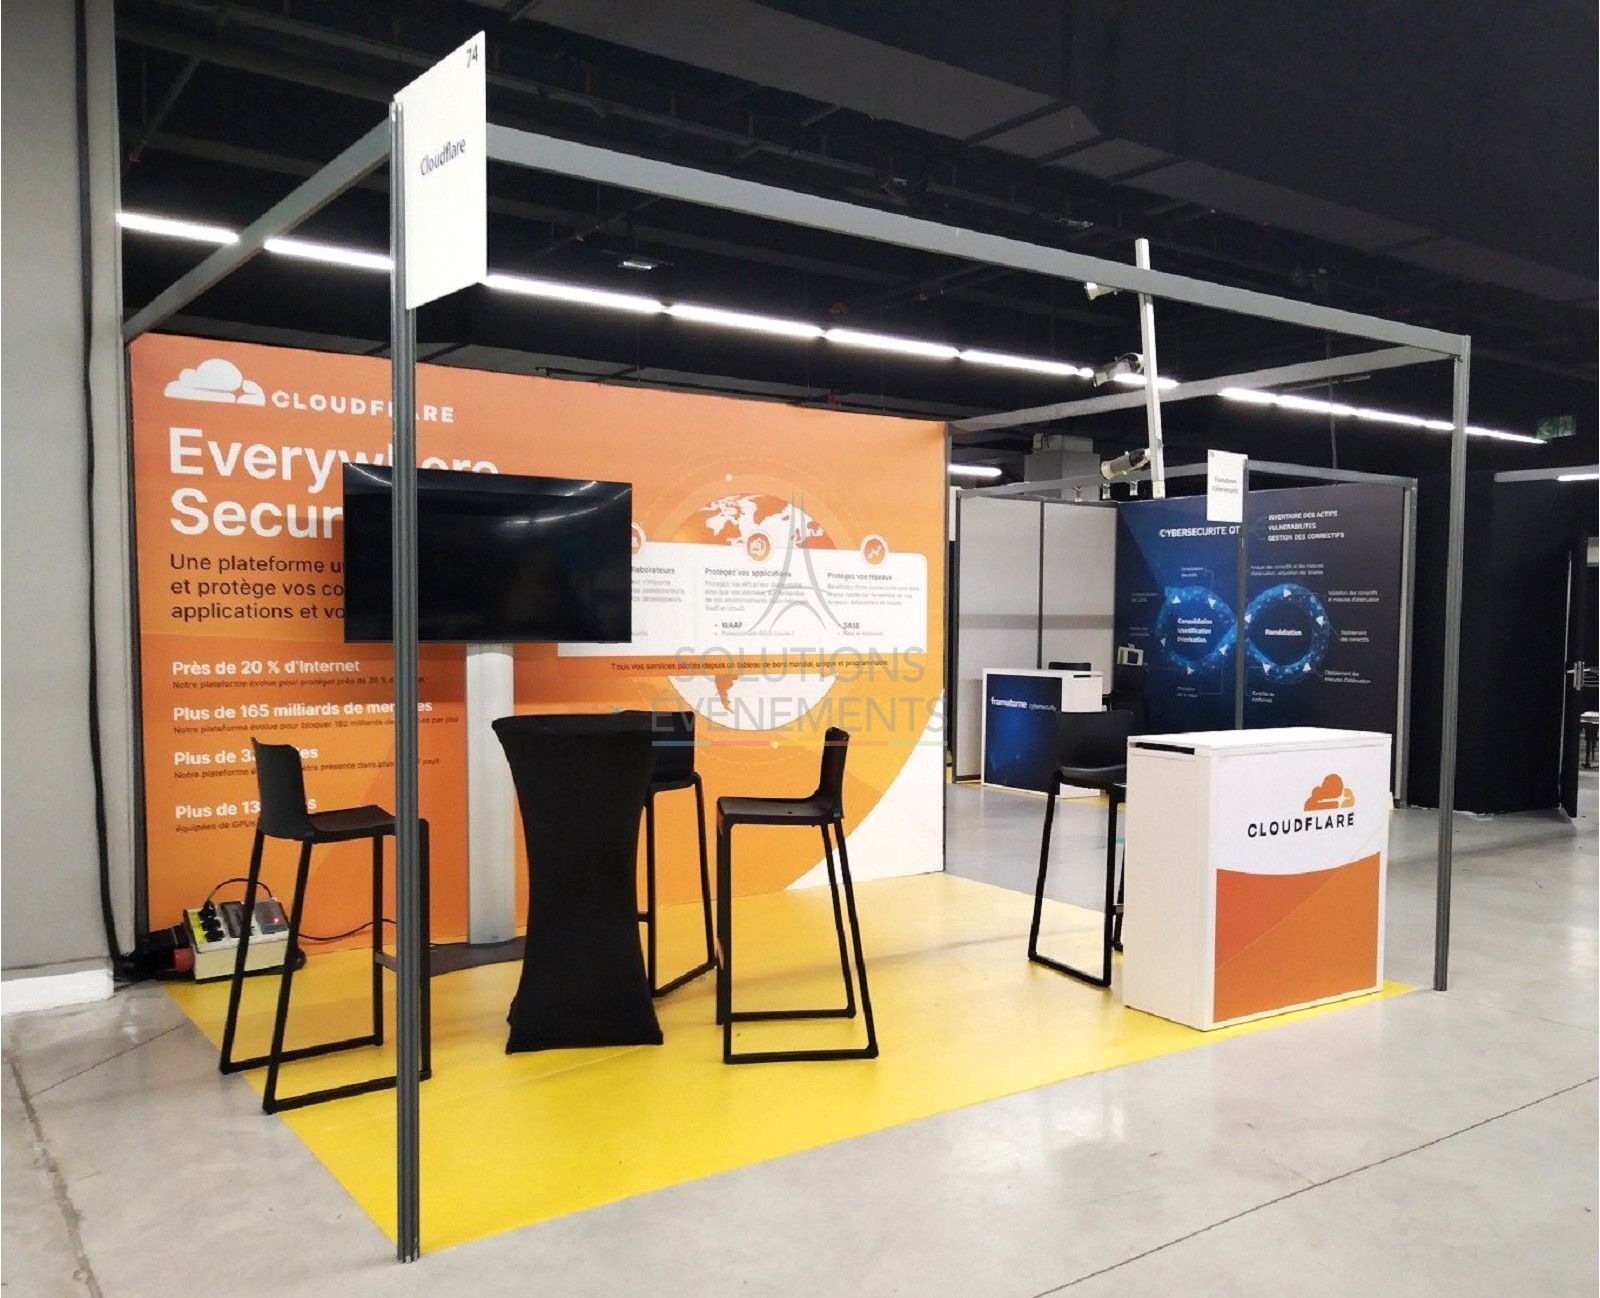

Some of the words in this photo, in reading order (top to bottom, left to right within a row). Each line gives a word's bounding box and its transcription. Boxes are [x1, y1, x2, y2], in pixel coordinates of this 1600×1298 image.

[466, 43, 479, 68] 74
[420, 138, 466, 176] Cloudflare
[271, 390, 455, 424] CLOUDFRE
[1159, 526, 1227, 538] CYBERSECURITE
[170, 554, 211, 570] Une
[218, 555, 325, 574] plateforme
[330, 561, 344, 574] u
[170, 580, 191, 595] et
[198, 578, 276, 599] protège
[282, 584, 316, 596] vos
[171, 602, 293, 623] applications
[300, 604, 318, 618] et
[172, 660, 211, 676] Près
[215, 660, 237, 675] de
[241, 660, 263, 675] 20
[267, 660, 280, 675] %
[284, 659, 361, 674] d'Internet
[611, 663, 630, 671] Tous
[646, 662, 676, 671] services
[701, 661, 726, 671] depuis
[173, 706, 211, 721] Plus
[214, 705, 236, 719] de
[240, 703, 270, 718] 165
[273, 702, 340, 717] milliards
[343, 702, 364, 715] de
[990, 696, 1028, 709] framatome
[174, 751, 212, 766] Plus
[214, 749, 237, 764] de
[175, 803, 213, 819] Plus
[216, 801, 238, 817] de
[1246, 811, 1356, 838] CLOUDFLARE
